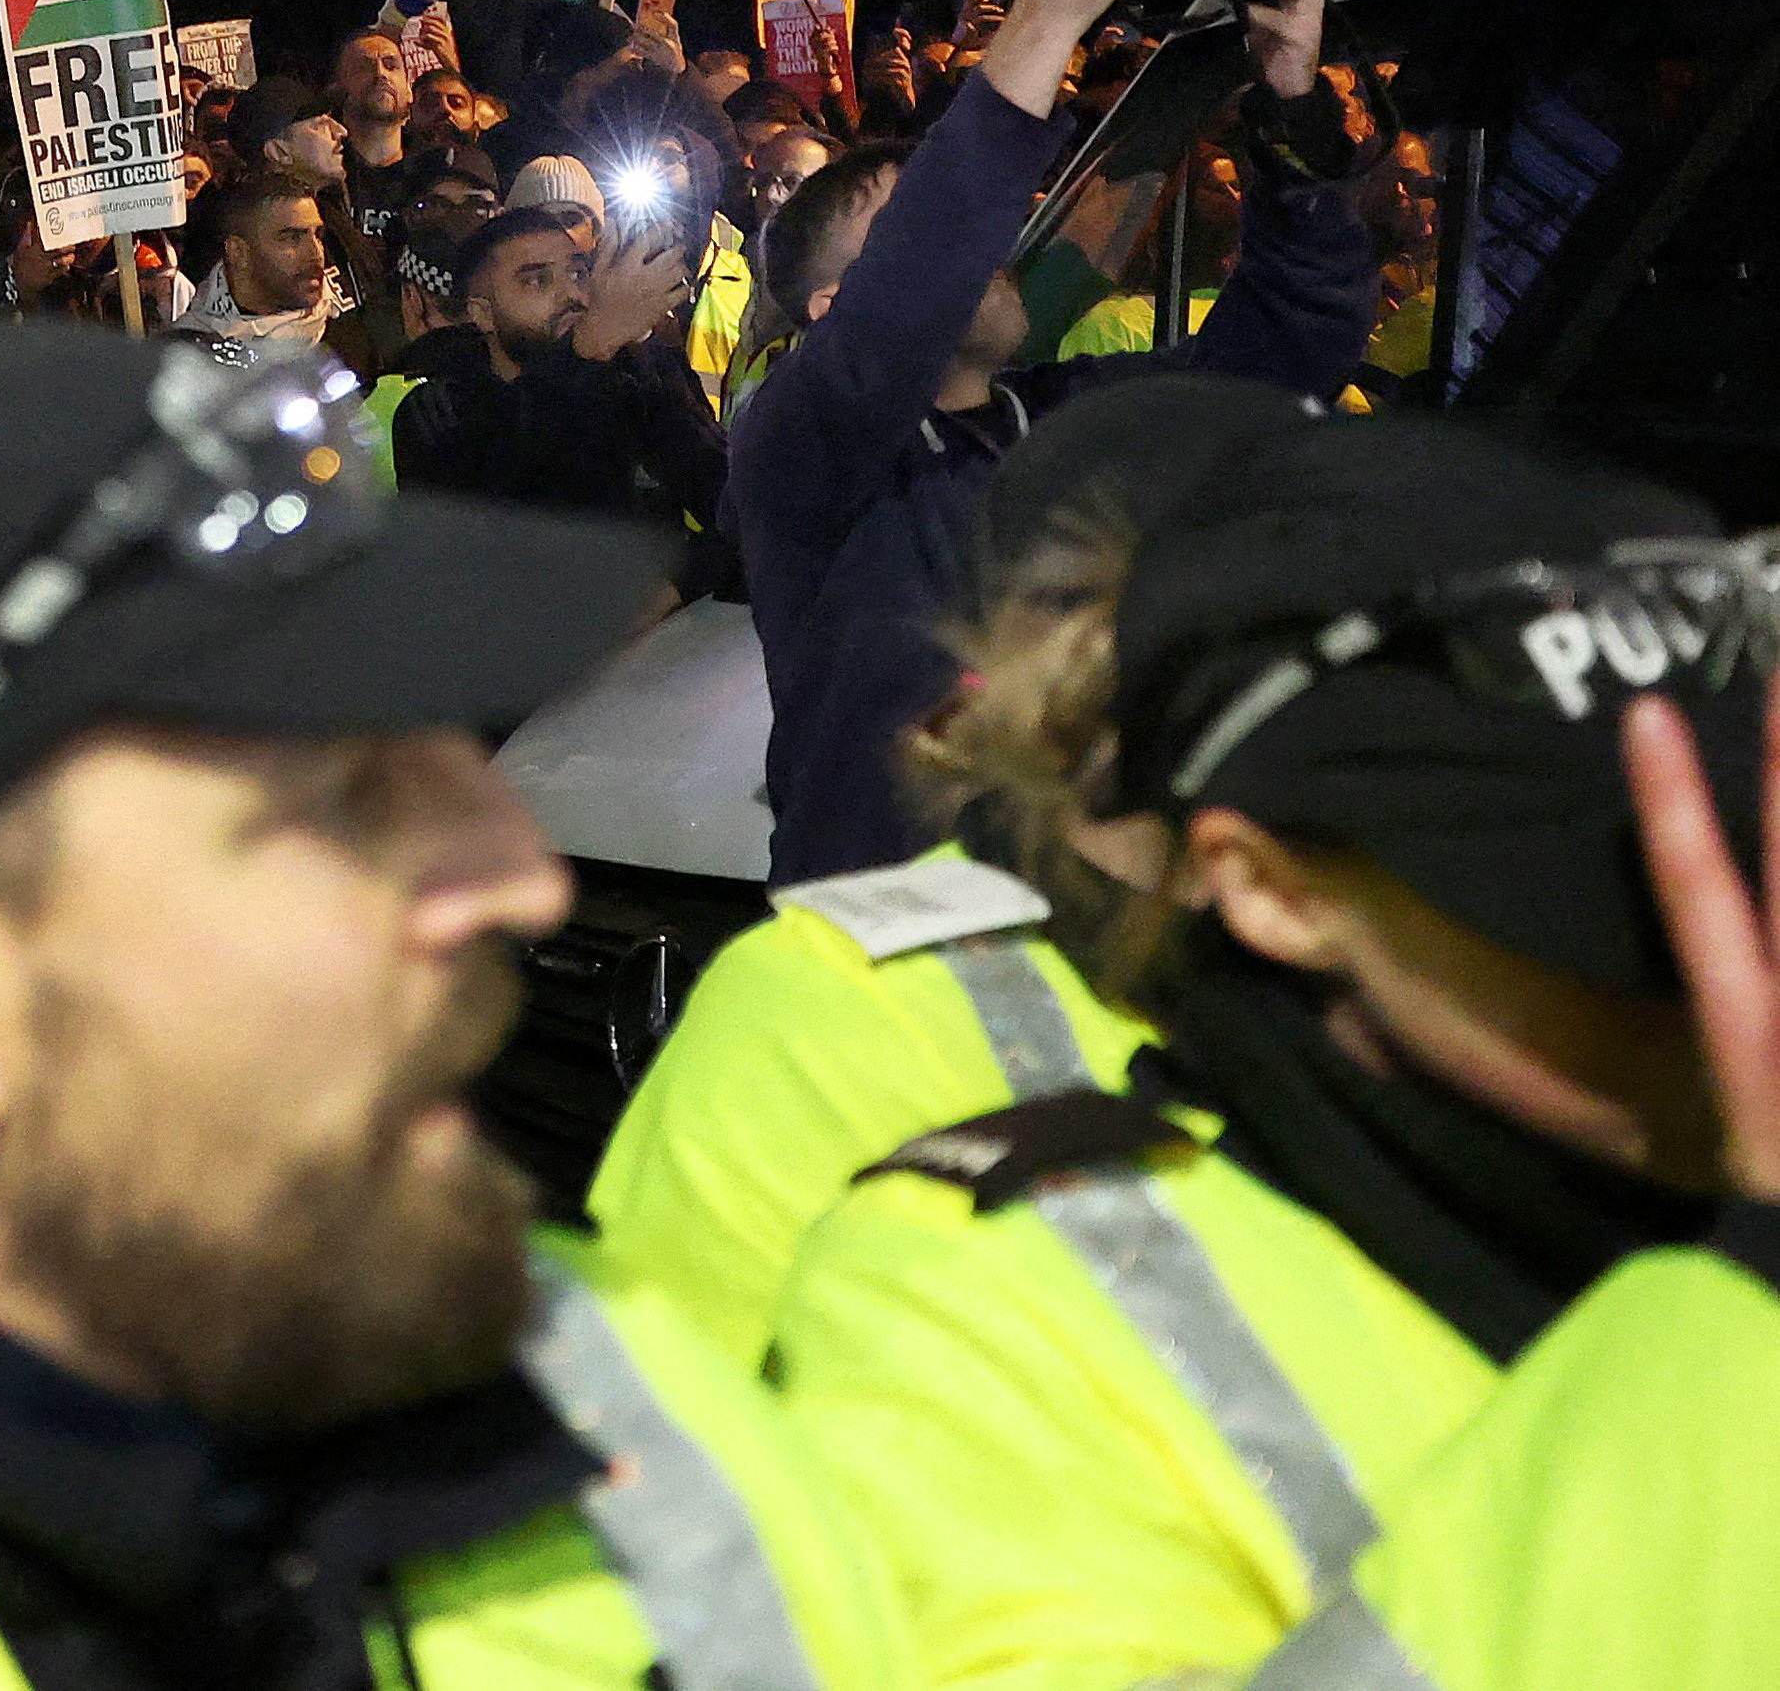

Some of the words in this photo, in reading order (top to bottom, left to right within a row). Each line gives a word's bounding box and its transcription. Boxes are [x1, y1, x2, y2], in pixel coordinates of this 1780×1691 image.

[185, 39, 219, 61] FROM
[222, 54, 238, 73] TO
[13, 30, 180, 137] FREE
[28, 112, 186, 178] PALESTIN
[40, 180, 66, 203] END
[67, 169, 119, 197] ISRAELI
